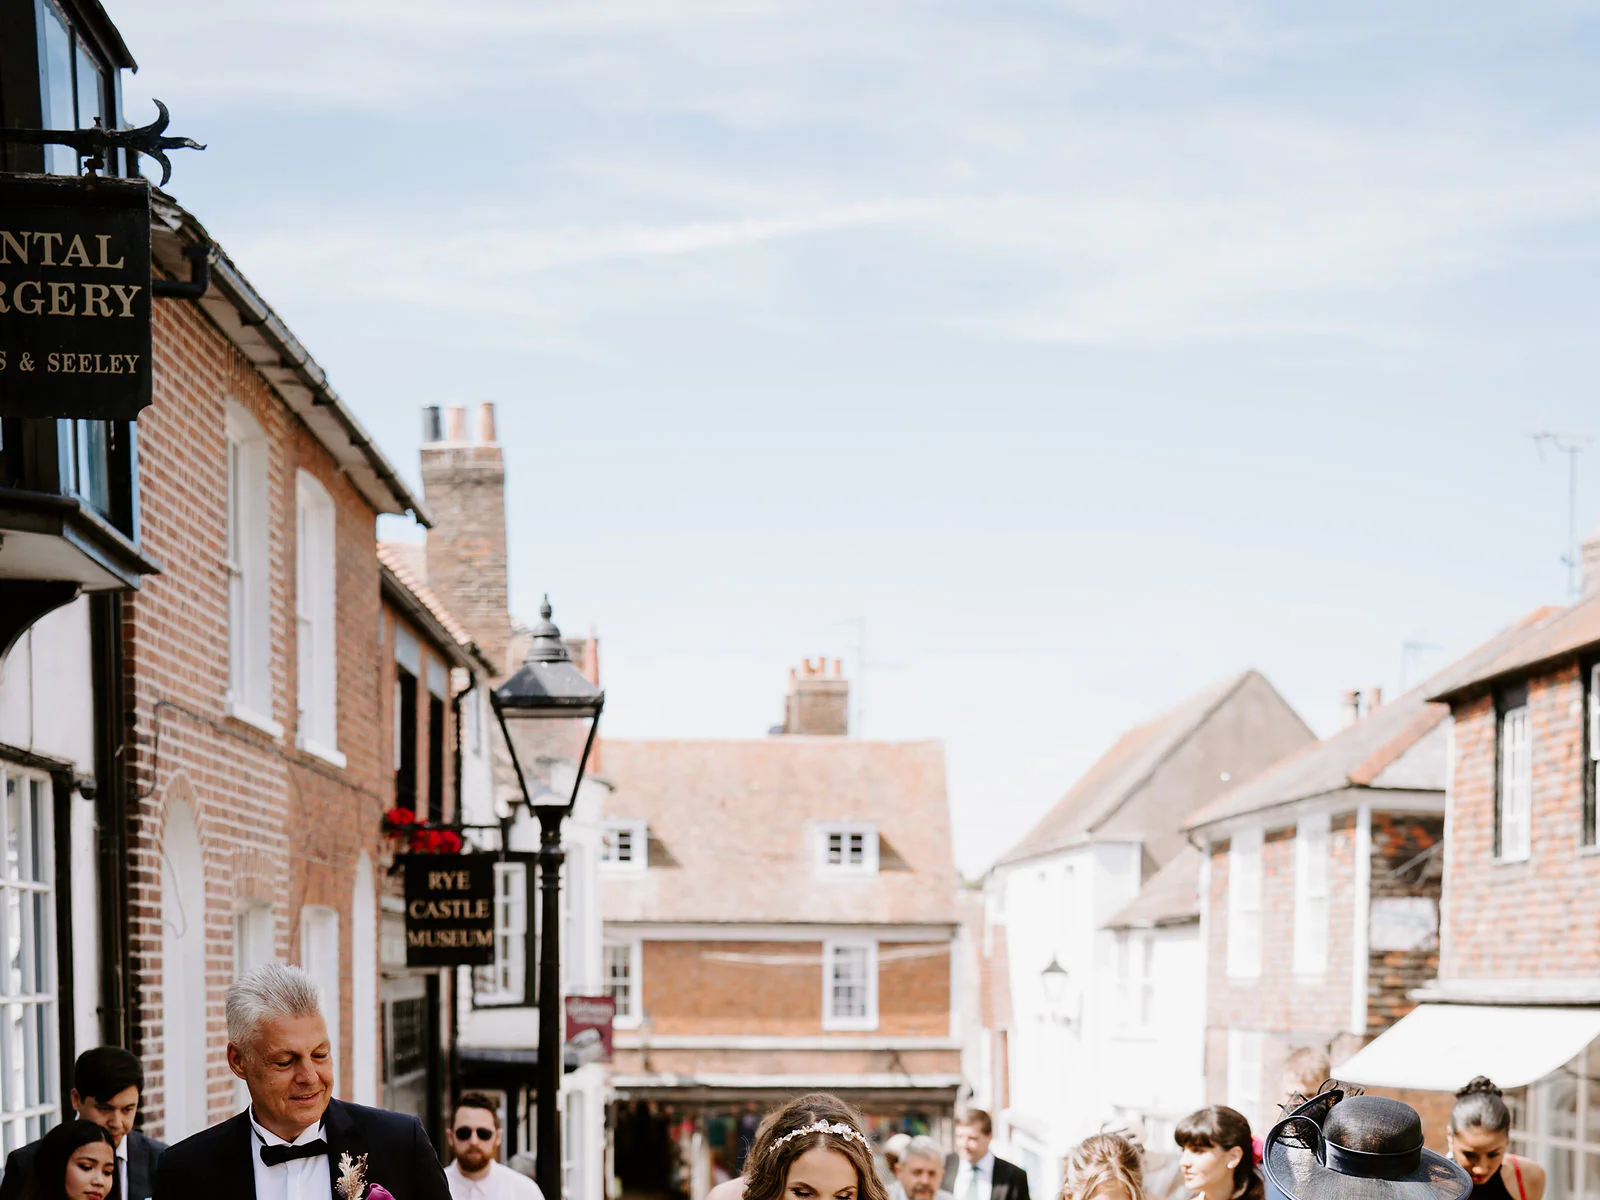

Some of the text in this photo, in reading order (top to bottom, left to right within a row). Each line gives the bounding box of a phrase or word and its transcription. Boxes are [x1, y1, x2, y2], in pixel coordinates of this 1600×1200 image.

[19, 352, 35, 372] &
[47, 353, 140, 374] SEELEY
[428, 870, 471, 890] RYE
[409, 899, 490, 919] CASTLE
[408, 929, 493, 948] MUSEUM
